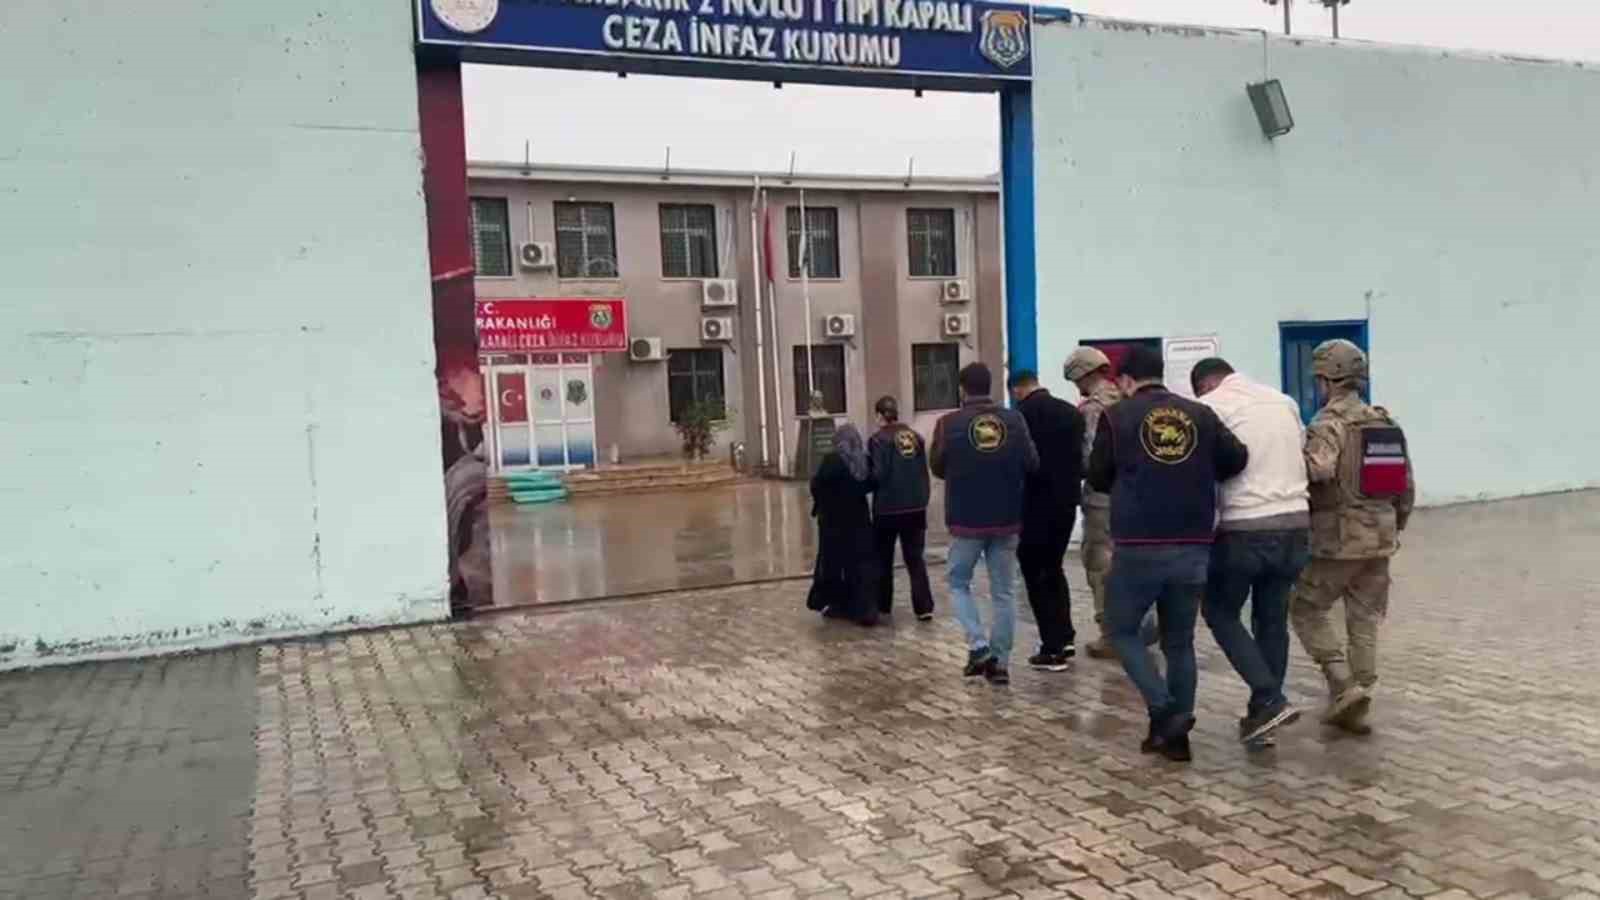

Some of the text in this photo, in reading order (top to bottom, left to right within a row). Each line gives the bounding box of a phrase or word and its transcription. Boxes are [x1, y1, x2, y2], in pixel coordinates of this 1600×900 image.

[884, 0, 973, 32] KAPALI
[602, 14, 901, 66] CEZA İNFAZ KURUMU
